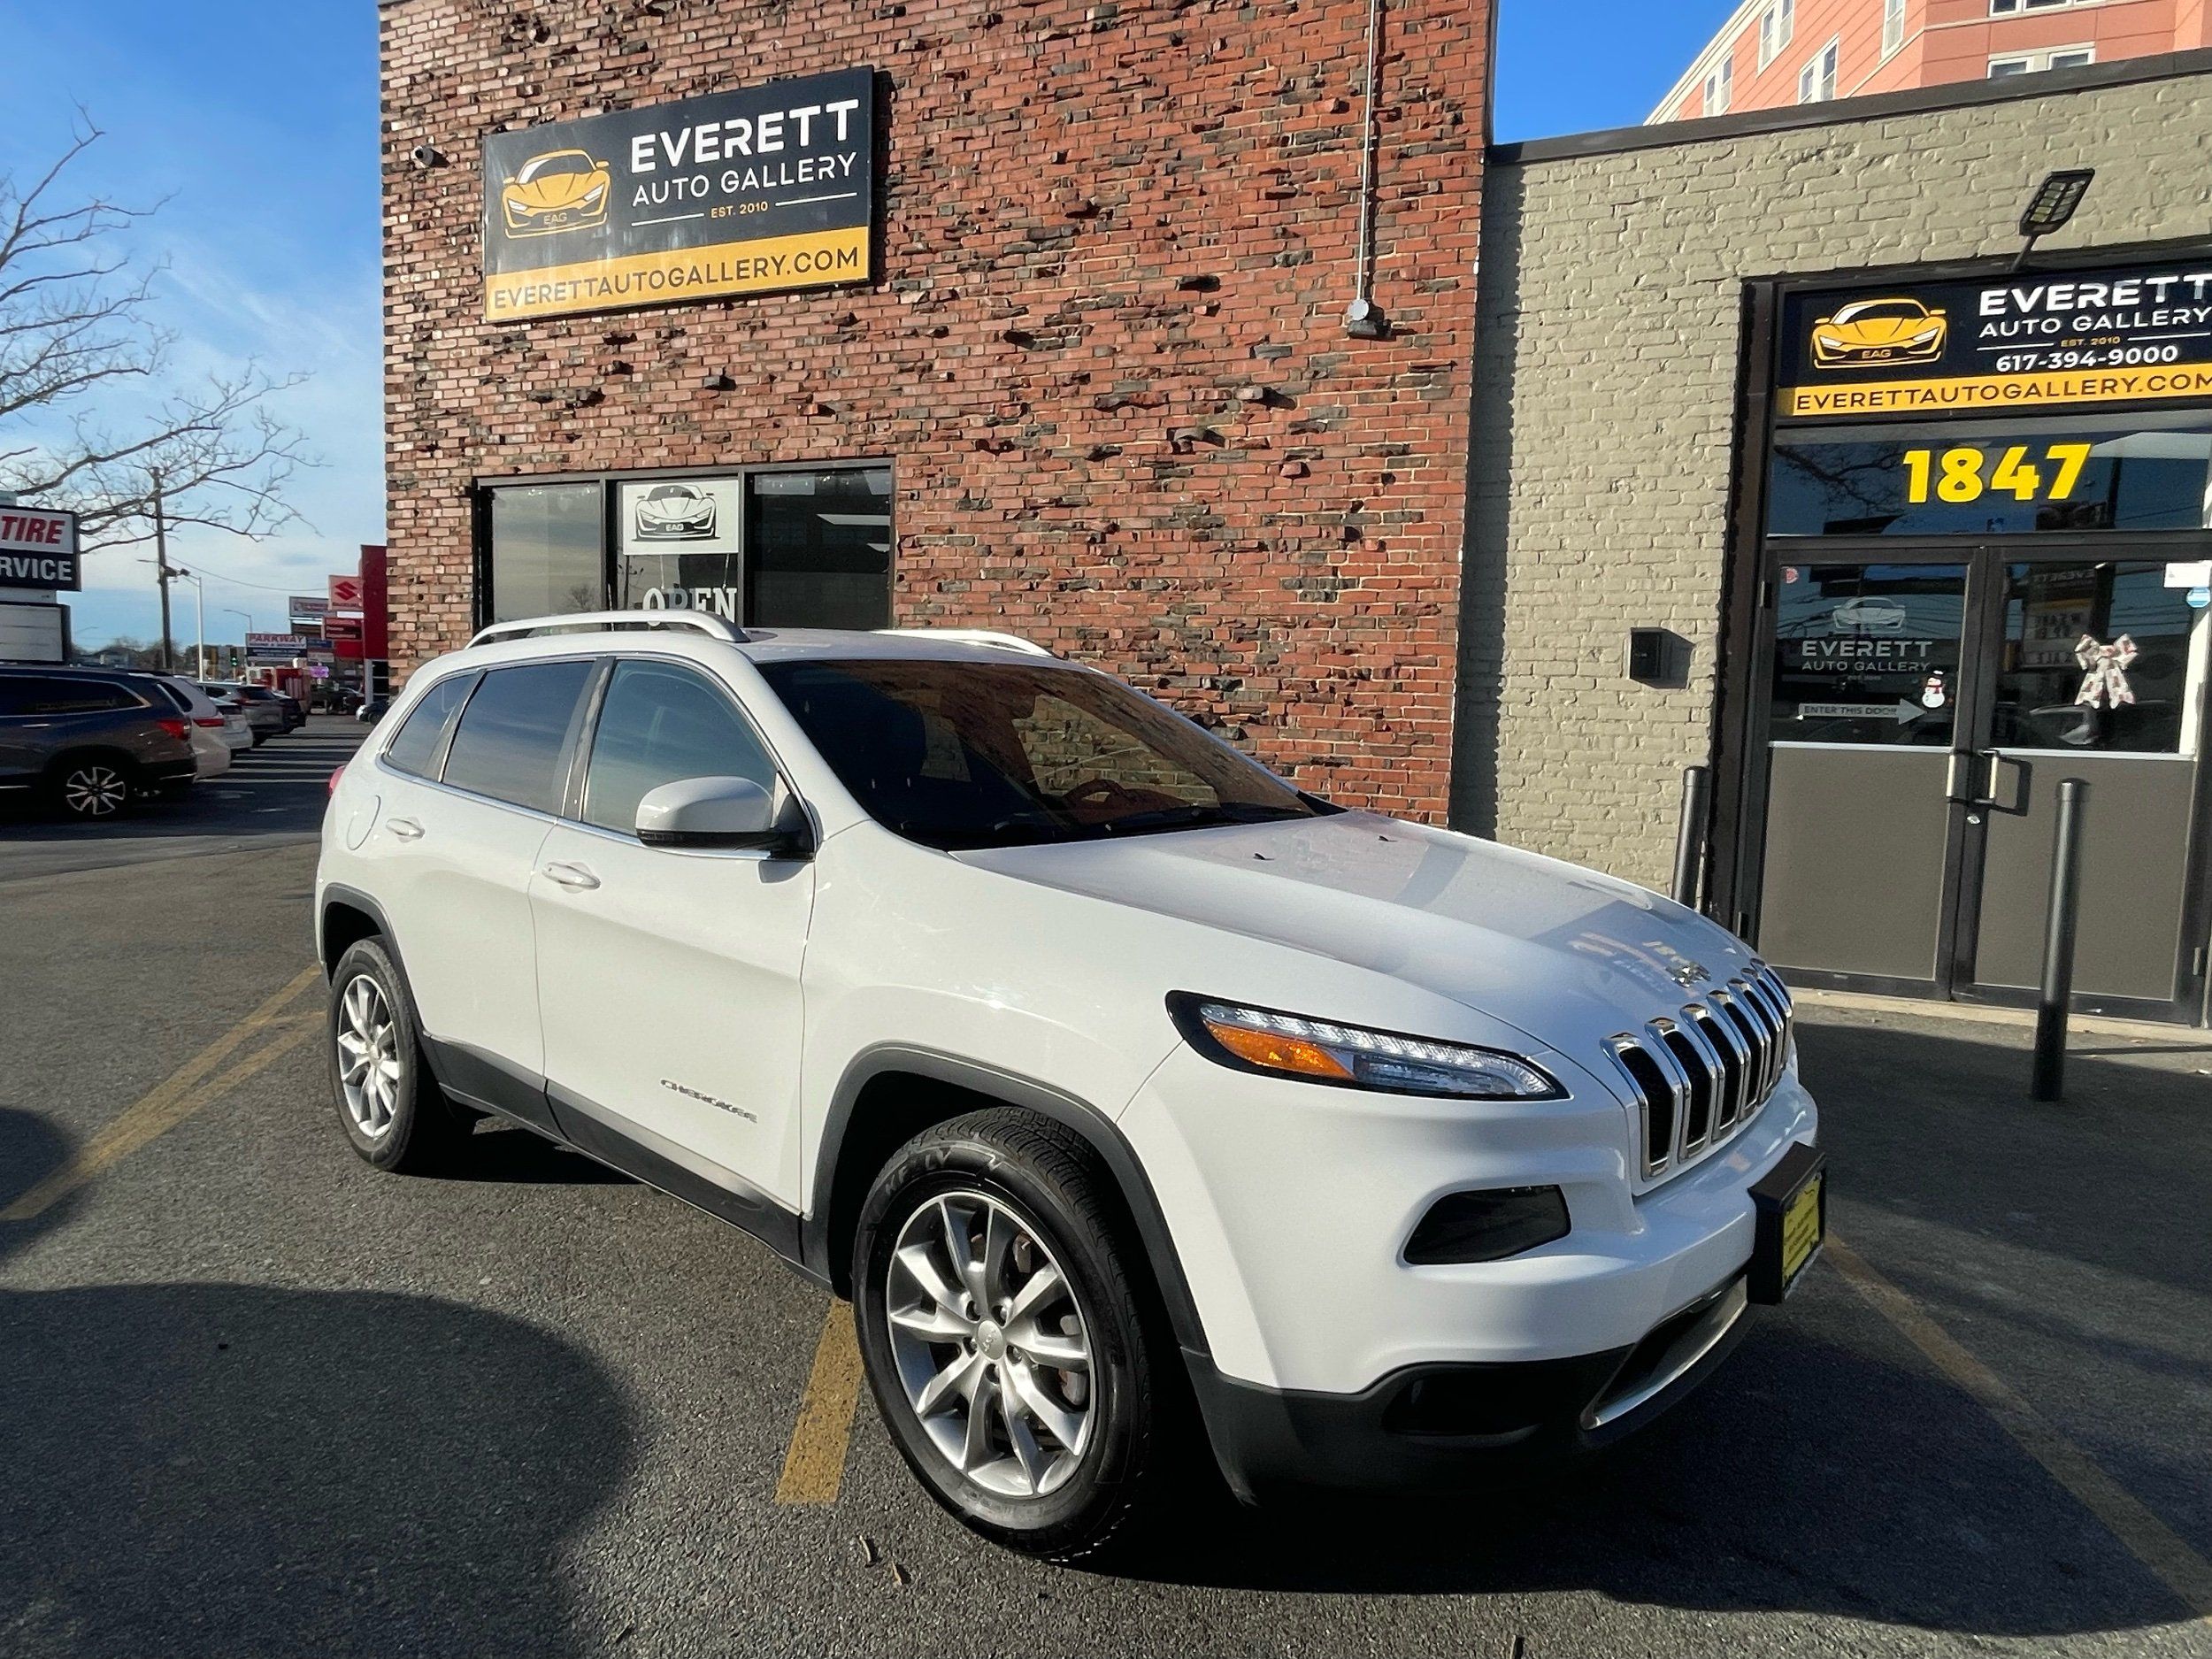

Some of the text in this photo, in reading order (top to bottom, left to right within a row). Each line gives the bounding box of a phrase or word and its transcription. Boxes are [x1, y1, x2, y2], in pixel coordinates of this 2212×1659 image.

[631, 99, 859, 173] EVERETT
[632, 151, 856, 207] AUTO GALLERY
[543, 213, 568, 226] EAG
[710, 202, 769, 219] EST. 2010
[494, 246, 859, 310] EVERETTAUTOGALLERY.COM
[1978, 273, 2212, 316] EVERETT
[1978, 307, 2212, 338] AUTO GALLERY
[2090, 335, 2121, 346] 2010
[1861, 348, 1892, 359] EAG
[1995, 345, 2179, 373] 617-394-9000
[1902, 443, 2093, 504] 1847
[1, 516, 65, 544] TIRE
[665, 522, 684, 532] EAG
[1801, 641, 1933, 657] EVERETT
[1801, 661, 1932, 672] AUTO GALLERY
[1804, 705, 1837, 714] ENTER
[1840, 705, 1862, 715] THIS
